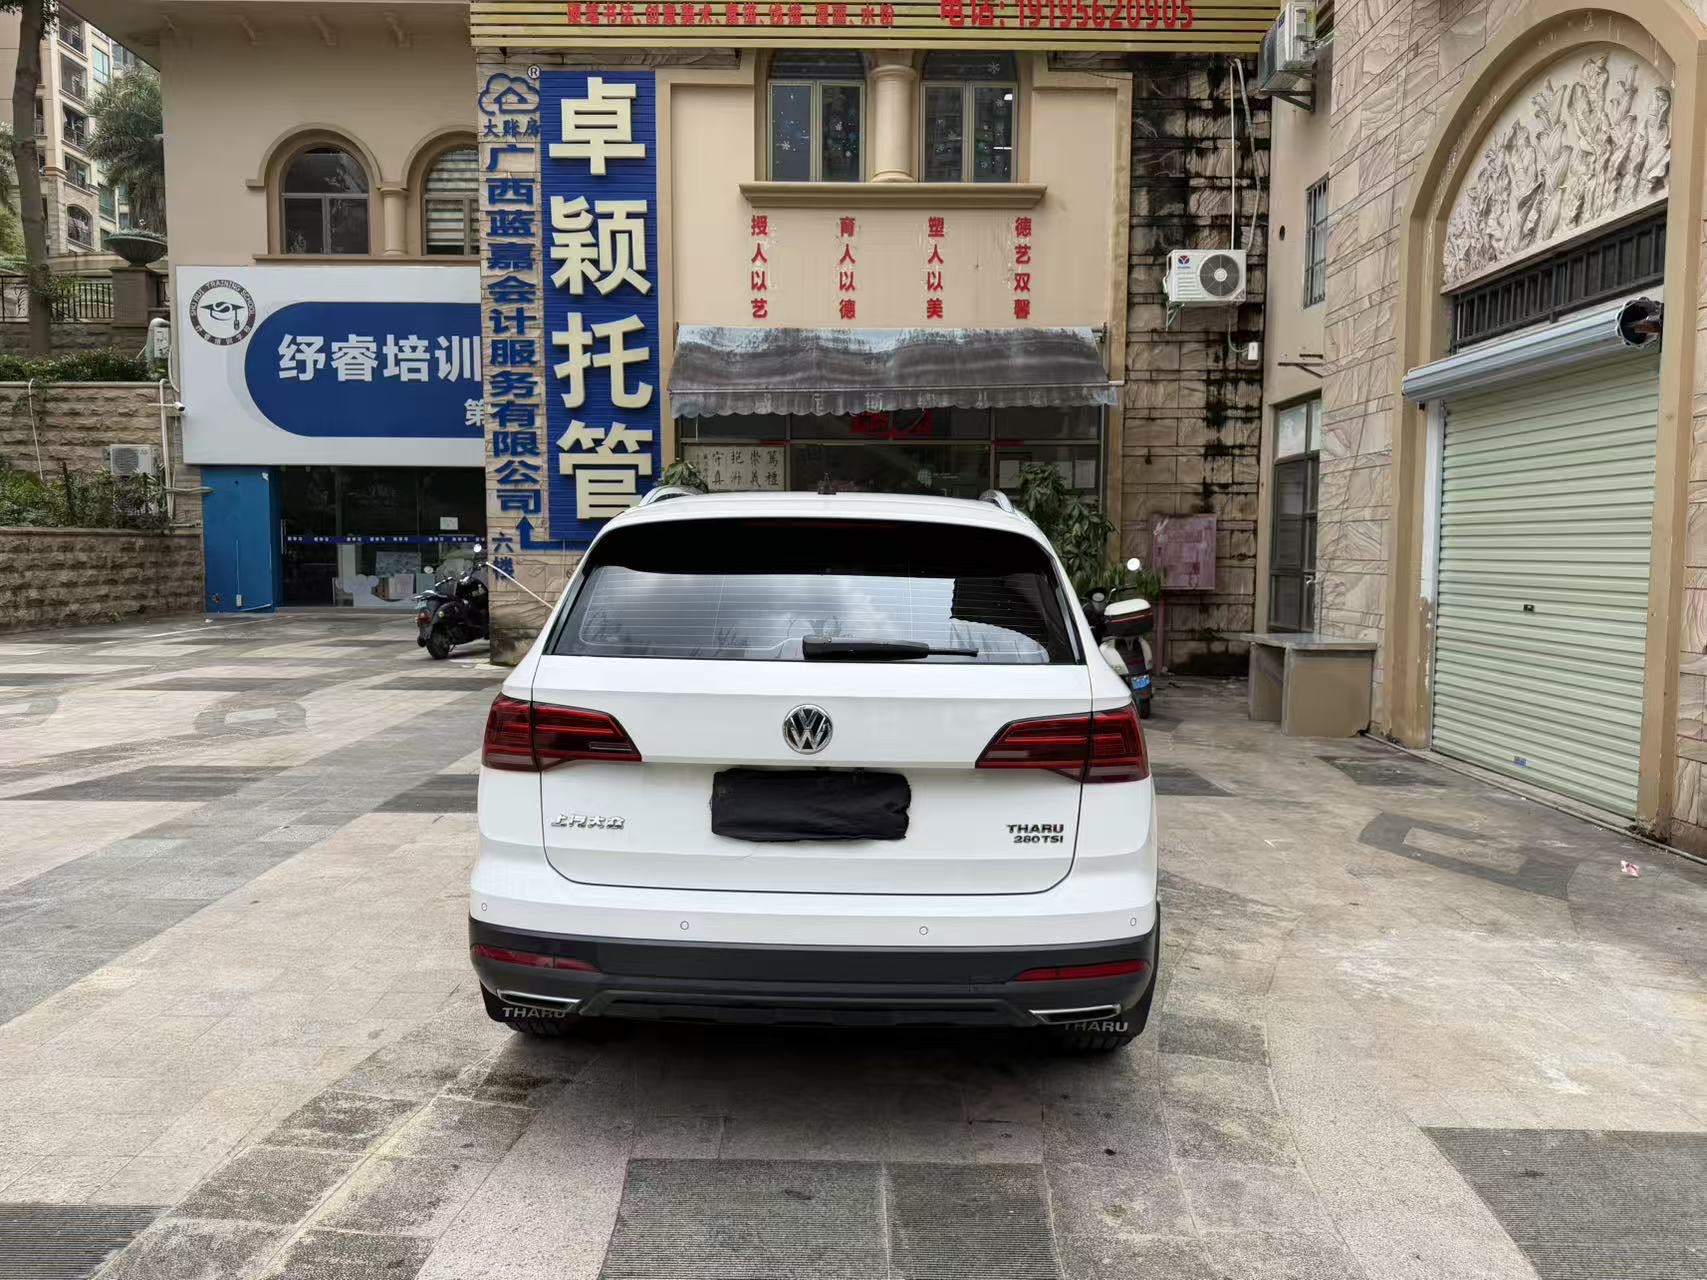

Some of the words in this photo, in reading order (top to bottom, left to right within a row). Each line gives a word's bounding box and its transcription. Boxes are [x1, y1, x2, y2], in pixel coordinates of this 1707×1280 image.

[548, 76, 654, 520] 卓颖托管
[751, 215, 768, 319] 授人以艺
[839, 216, 856, 320] 育人以德
[926, 216, 945, 320] 塑人以美
[1014, 216, 1032, 320] 德艺双馨
[277, 333, 482, 383] 纾睿培训
[485, 143, 542, 514] 广西蓝嘉会计服务有限公司
[1006, 823, 1065, 835] THARU
